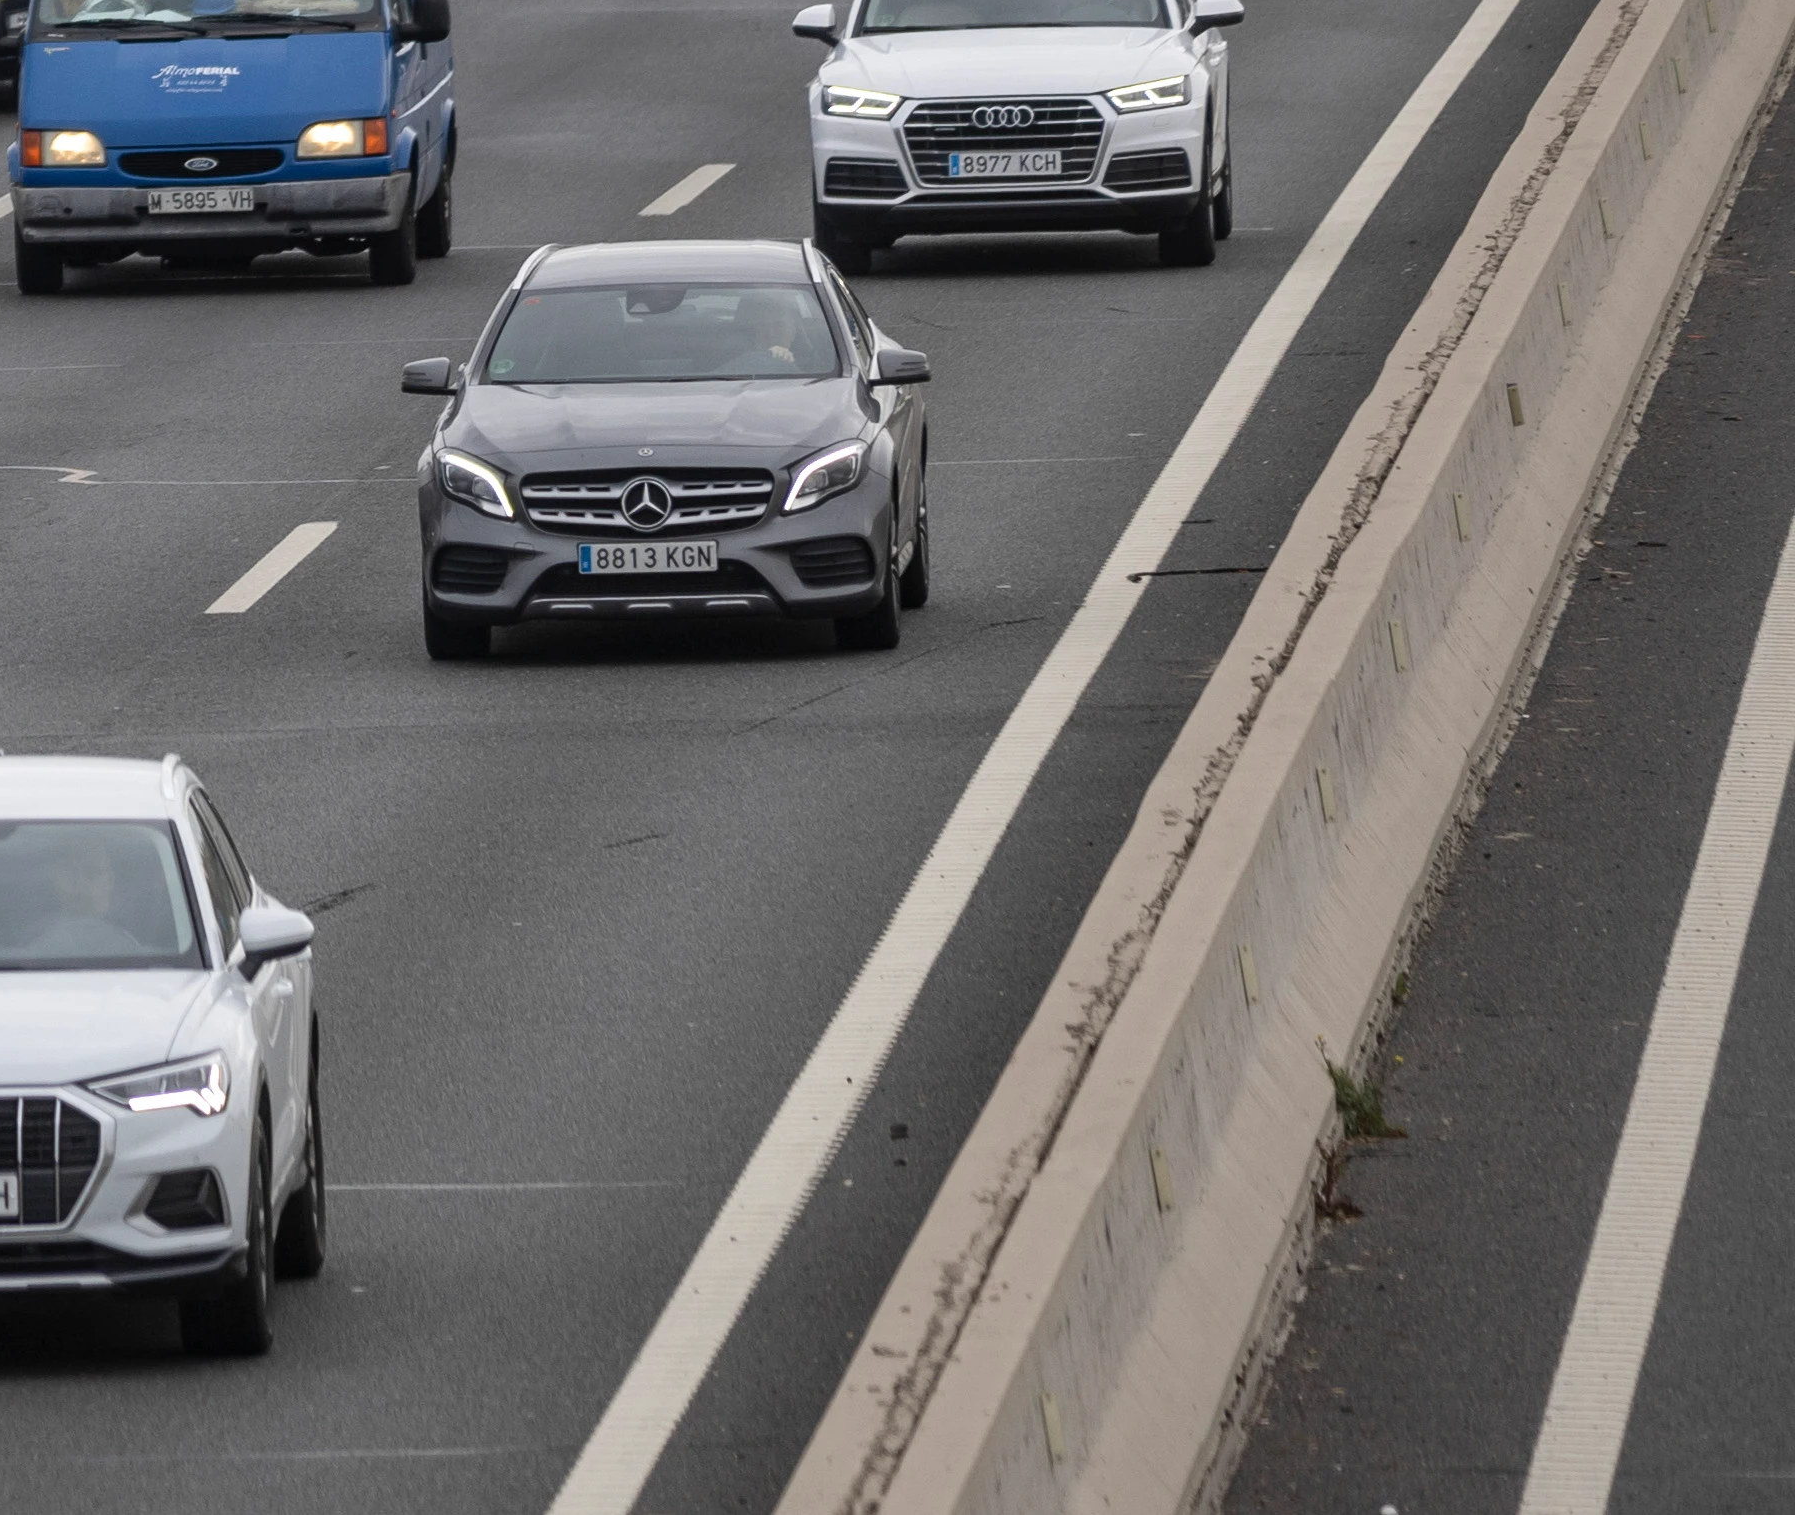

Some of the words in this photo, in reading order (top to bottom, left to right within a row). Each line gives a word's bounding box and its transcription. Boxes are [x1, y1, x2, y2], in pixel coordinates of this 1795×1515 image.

[963, 154, 1011, 176] 8977
[1019, 152, 1058, 173] KCH
[596, 547, 657, 570] 8813
[665, 545, 713, 568] KGN
